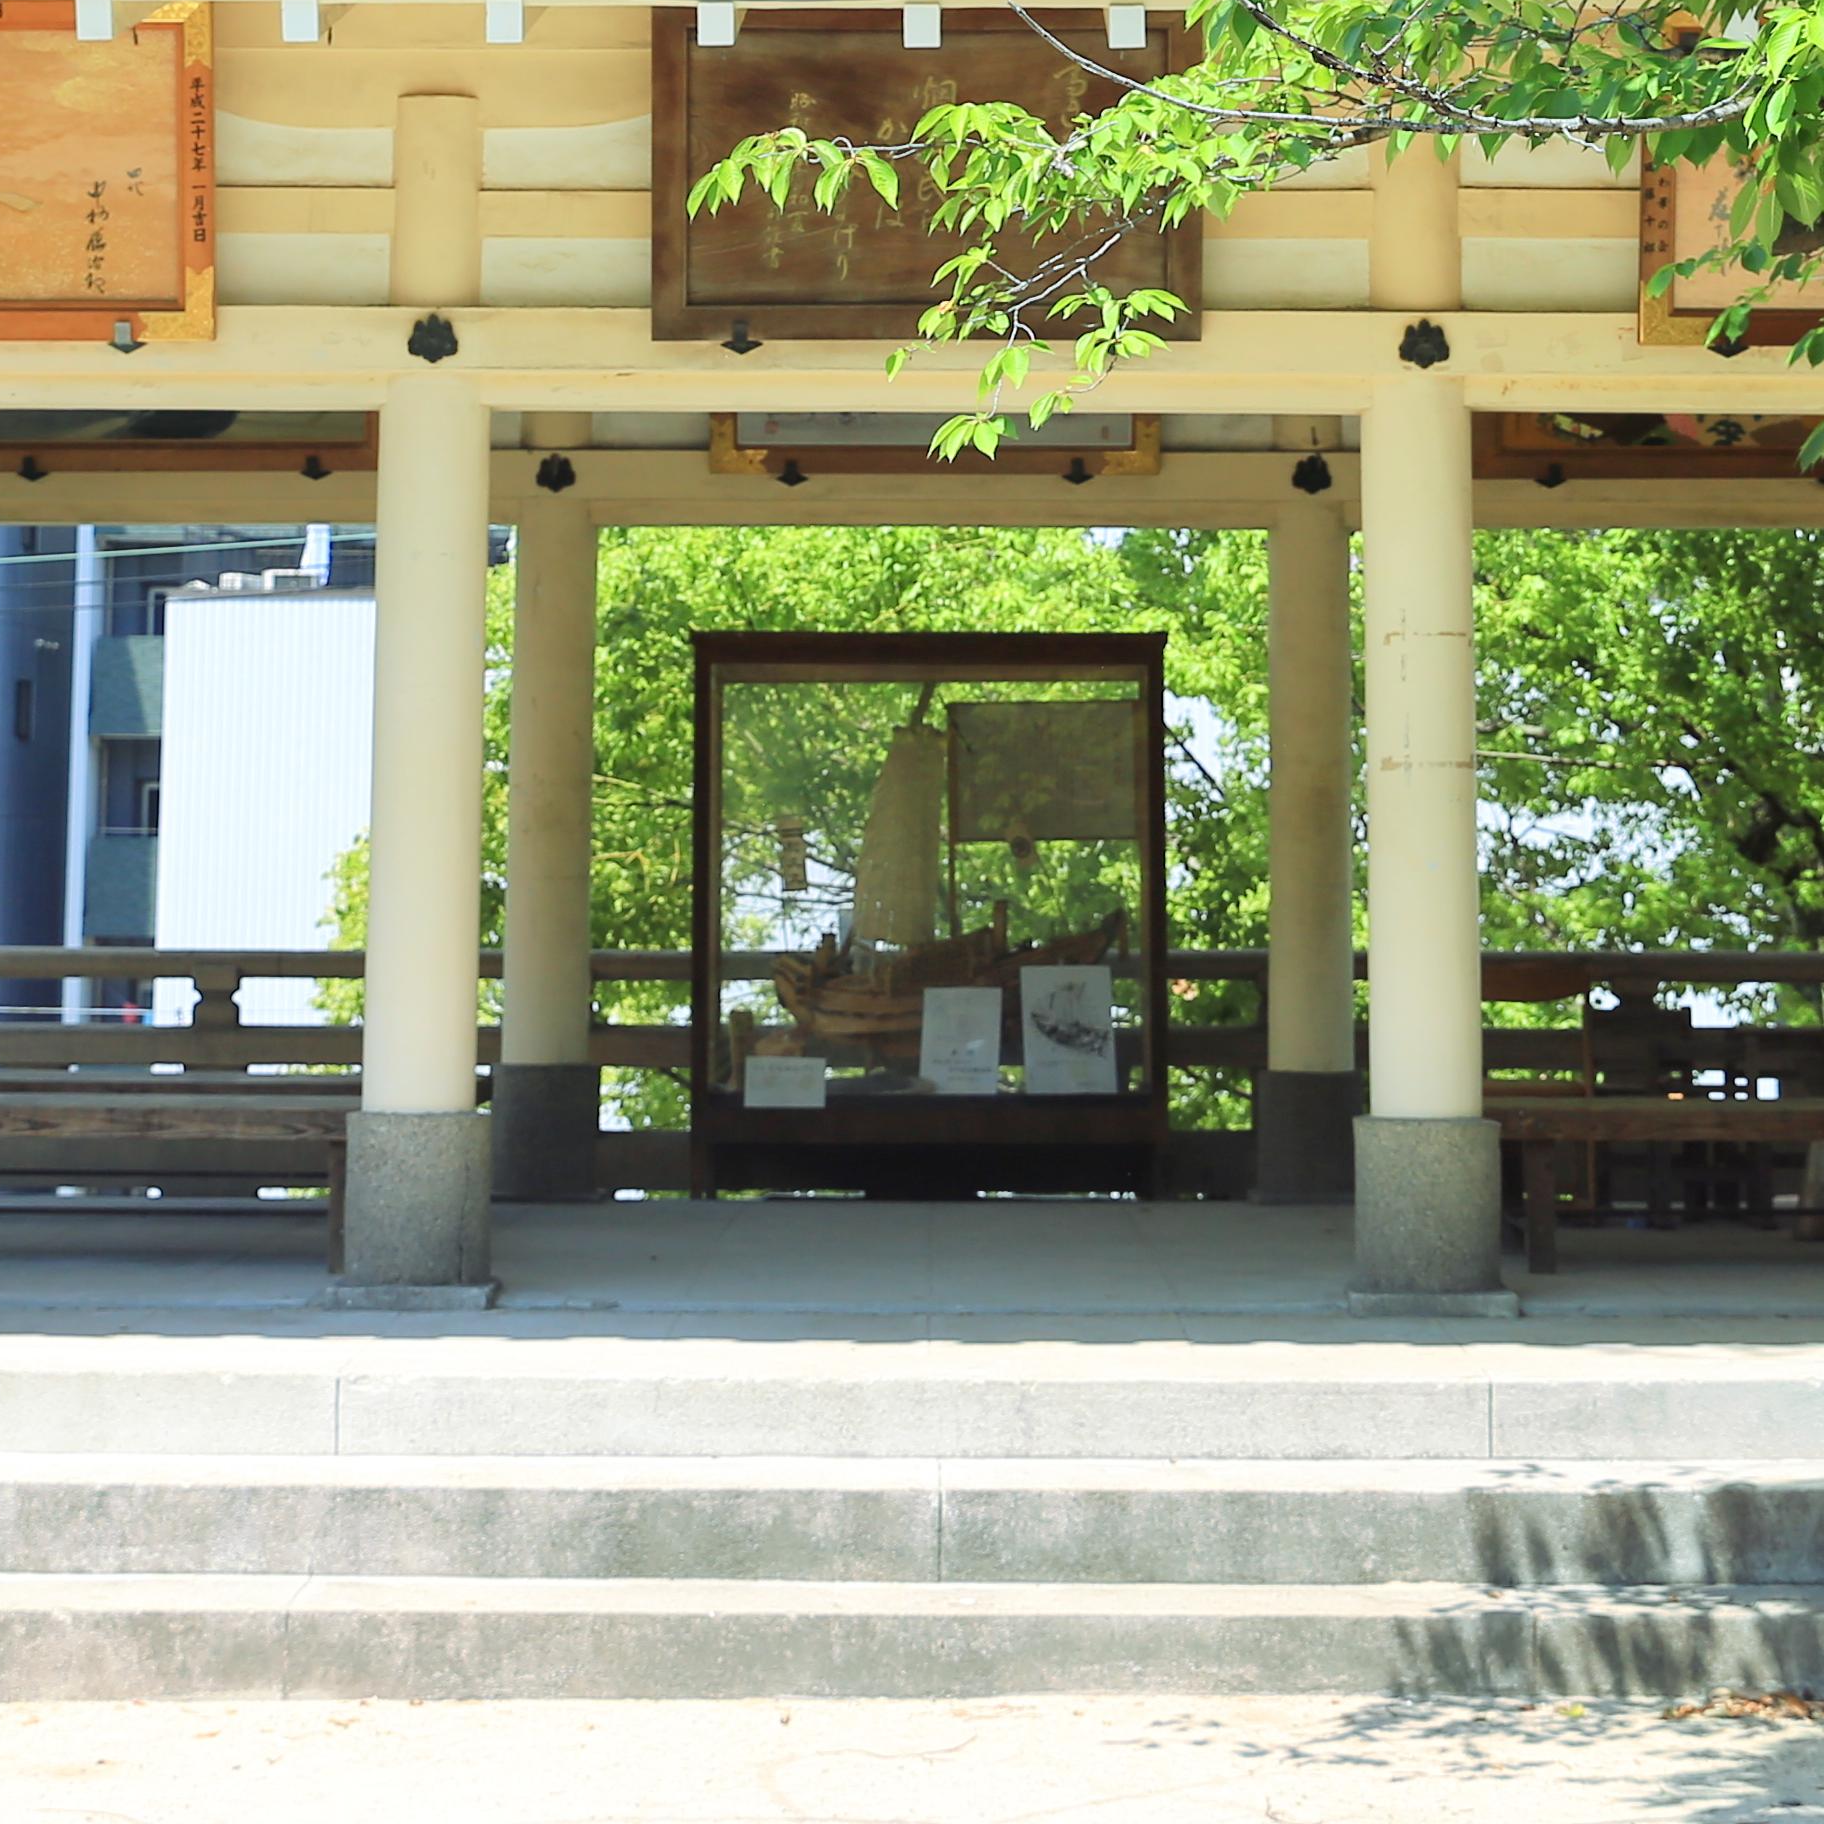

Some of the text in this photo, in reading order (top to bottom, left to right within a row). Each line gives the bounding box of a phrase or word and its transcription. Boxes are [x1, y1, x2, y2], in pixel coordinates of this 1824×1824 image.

[189, 76, 208, 244] 平成二十七年 一月吉日
